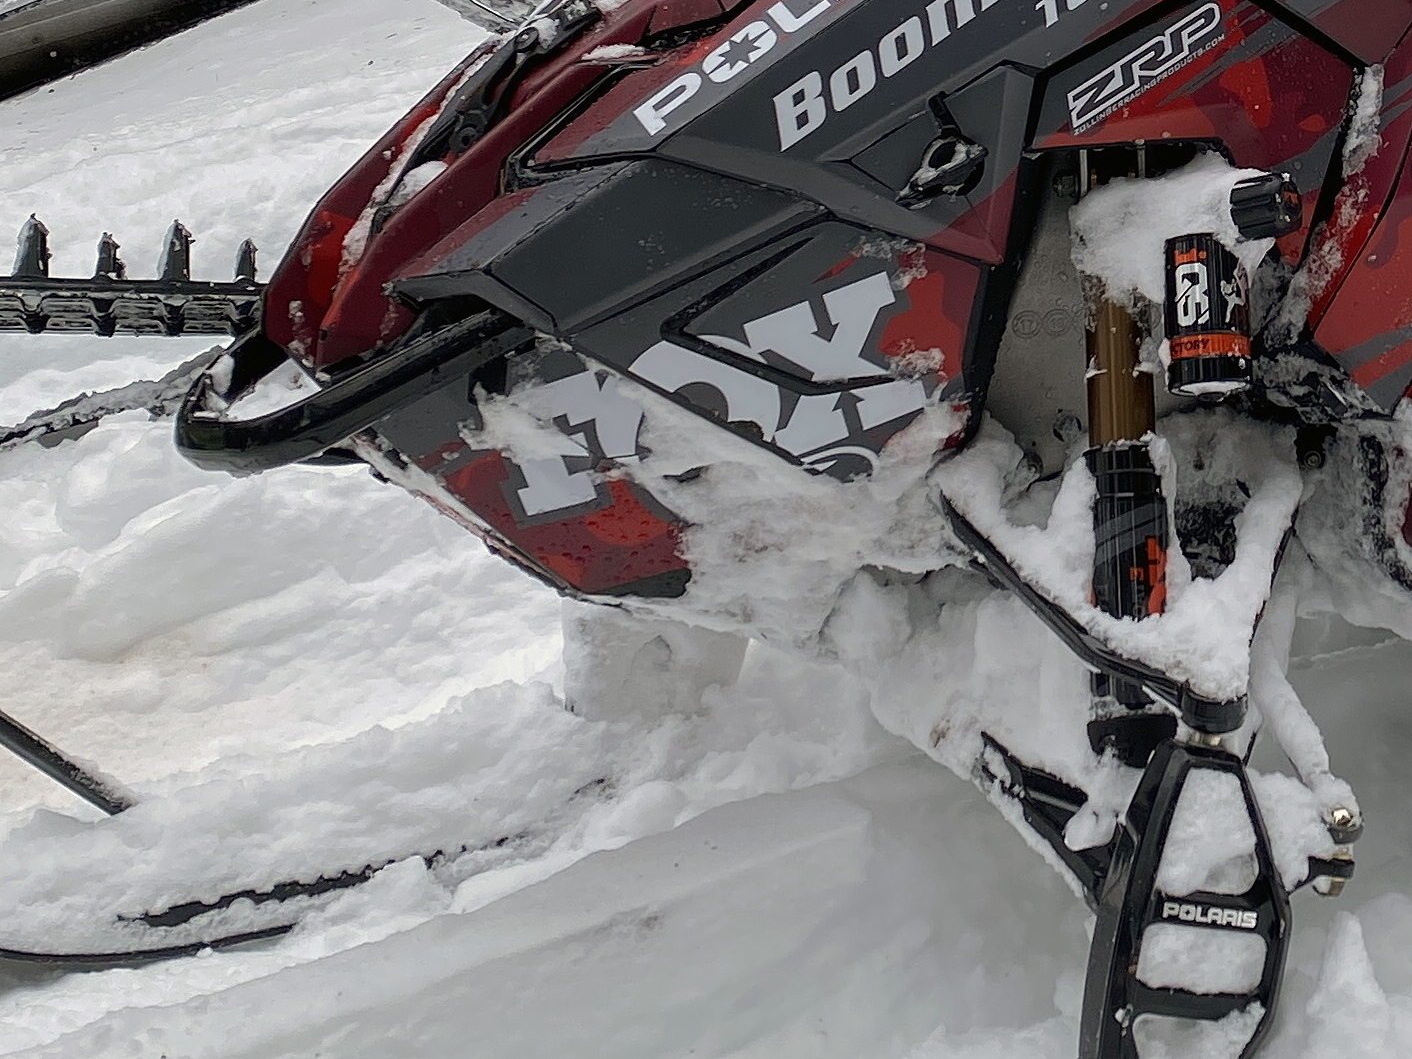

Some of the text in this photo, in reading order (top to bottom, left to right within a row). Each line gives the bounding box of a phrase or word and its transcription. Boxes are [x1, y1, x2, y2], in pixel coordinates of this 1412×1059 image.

[1067, 2, 1221, 129] ZRP
[517, 271, 925, 517] FOX
[1161, 901, 1258, 929] POLARIS
